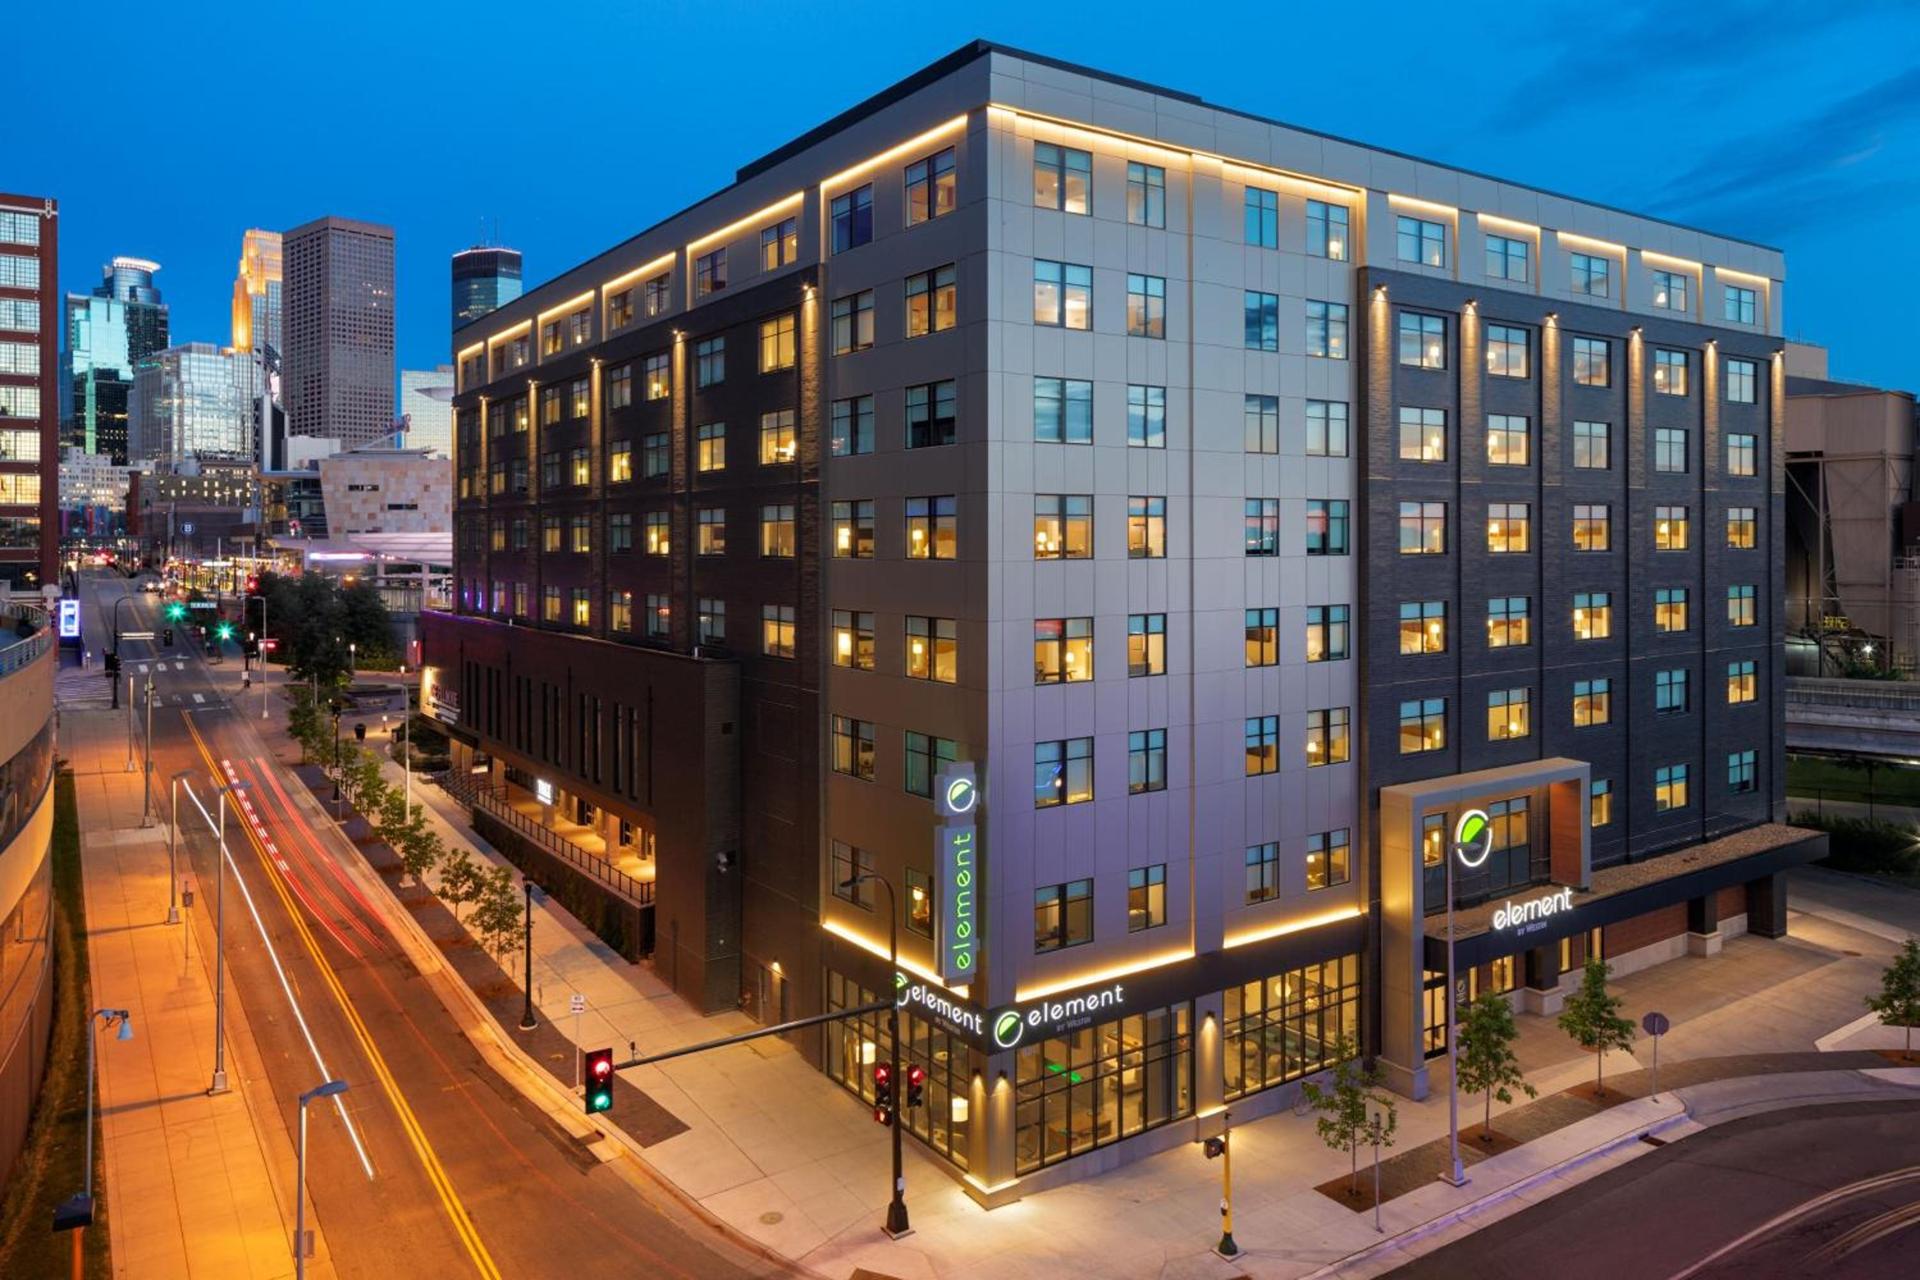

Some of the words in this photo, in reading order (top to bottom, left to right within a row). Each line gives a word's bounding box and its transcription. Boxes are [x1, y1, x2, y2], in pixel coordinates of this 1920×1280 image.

[952, 832, 971, 970] element
[1493, 886, 1573, 930] element
[911, 985, 983, 1035] element
[1028, 984, 1124, 1026] element
